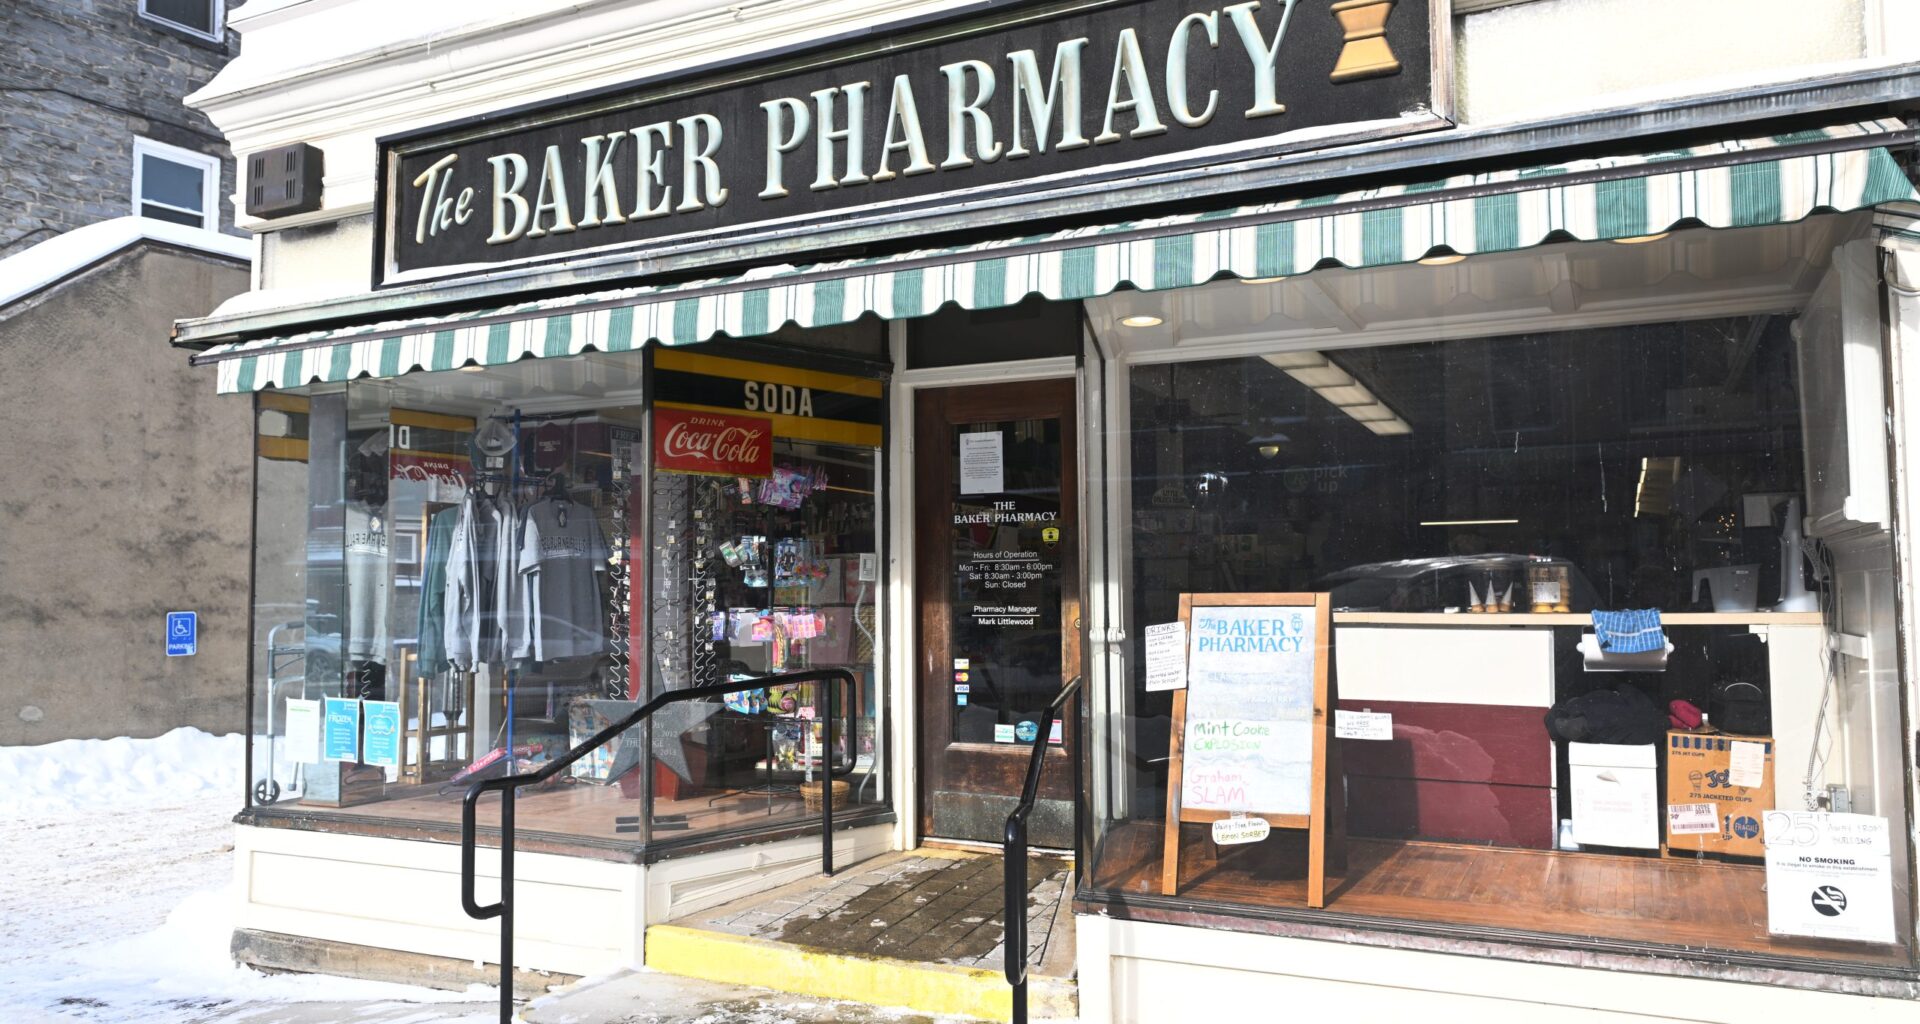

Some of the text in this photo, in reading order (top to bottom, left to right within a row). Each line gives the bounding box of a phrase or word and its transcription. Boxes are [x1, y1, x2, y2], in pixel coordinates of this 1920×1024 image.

[412, 0, 1302, 246] The BAKER PHARMACY
[744, 381, 814, 417] SODA
[690, 417, 726, 427] DRINK
[664, 422, 761, 464] Coca-Cola
[1314, 464, 1348, 481] pick
[1318, 481, 1338, 494] up
[994, 501, 1016, 510] THE
[954, 512, 1057, 524] BAKER PHARMACY
[1003, 551, 1038, 559] Operation
[1026, 563, 1053, 572] 6:00pm
[984, 572, 1010, 580] 8:30am
[1016, 572, 1042, 580] 3:00pm
[1002, 580, 1027, 588] Closed
[973, 605, 1038, 613] Pharmacy Manager
[1216, 619, 1286, 636] BAKER
[1198, 636, 1303, 652] PHARMACY
[1194, 721, 1230, 736] Mint
[1191, 786, 1245, 804] SLAM
[1735, 822, 1758, 833] FRAGILE
[1814, 857, 1855, 865] SMOKING
